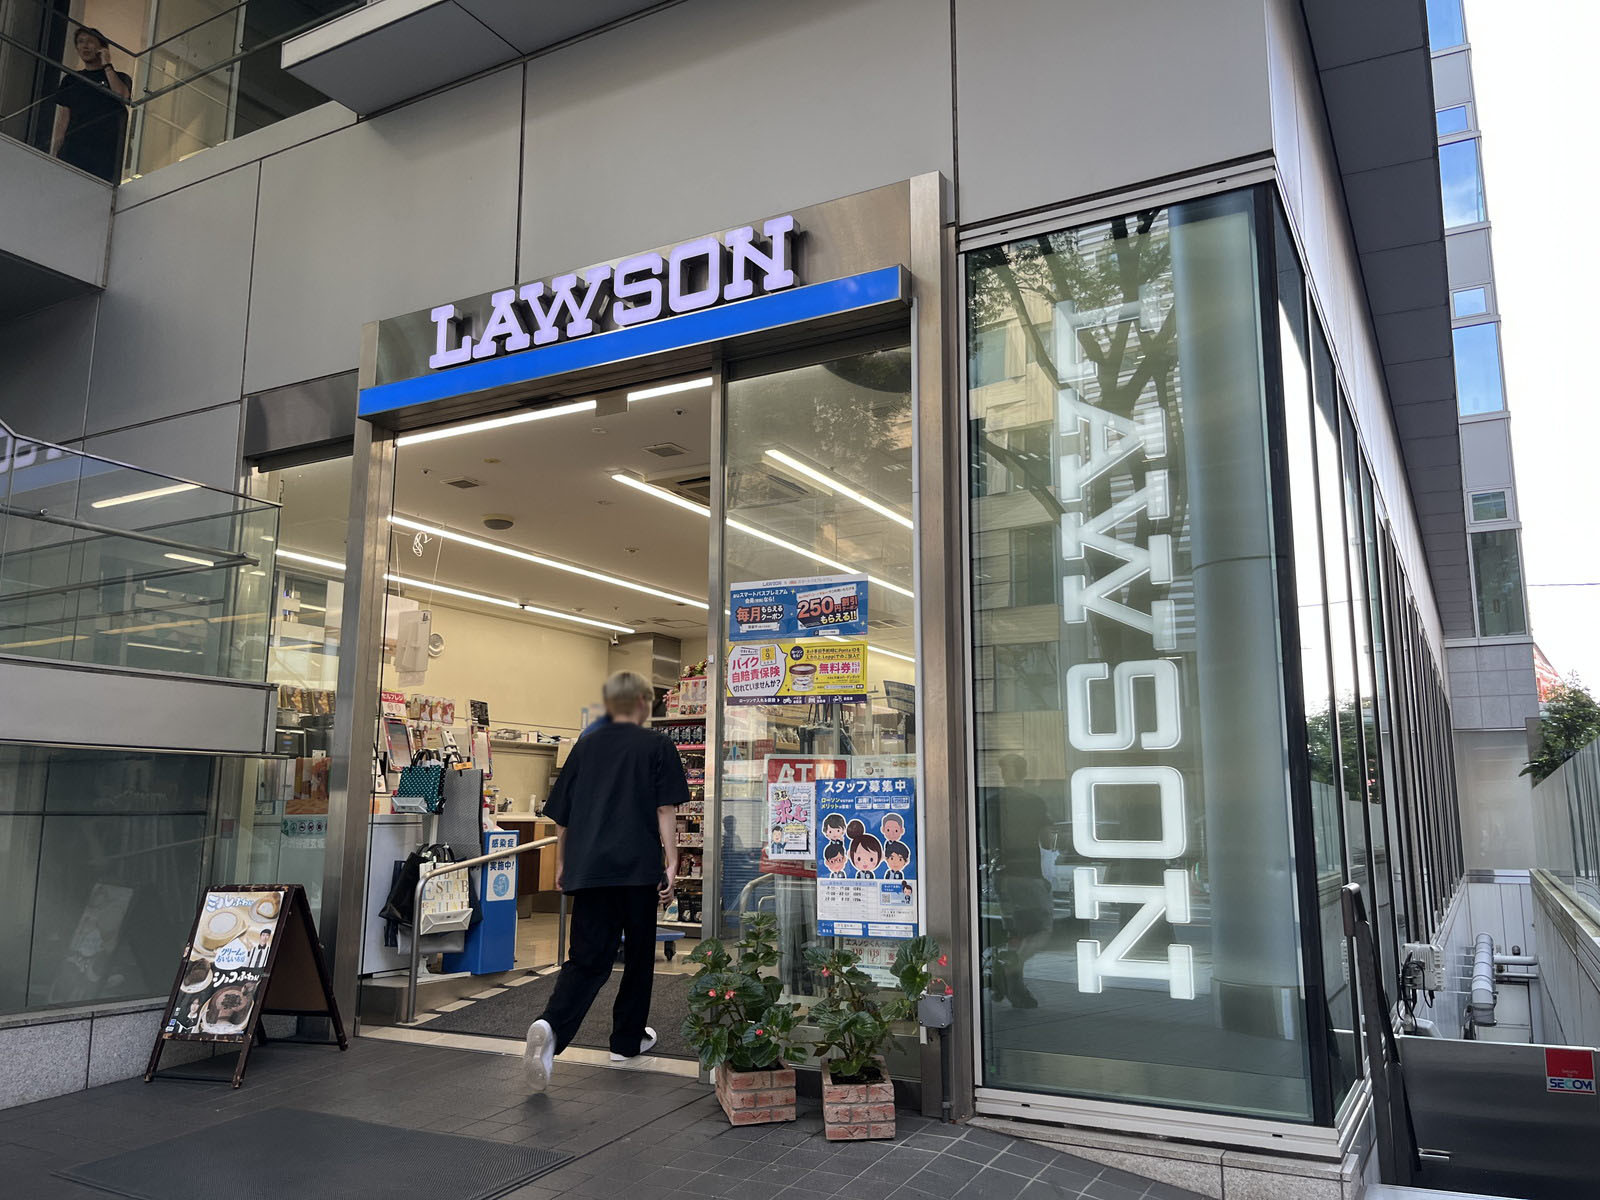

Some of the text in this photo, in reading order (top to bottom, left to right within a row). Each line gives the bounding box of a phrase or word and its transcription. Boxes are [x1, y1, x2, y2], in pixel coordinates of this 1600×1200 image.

[429, 214, 795, 369] LAWSON
[1055, 300, 1196, 1001] LAWSON
[732, 656, 759, 670] バイク
[818, 661, 851, 675] 無料券
[732, 665, 780, 683] 自賠責保険
[776, 763, 835, 784] ATM
[824, 779, 907, 794] スタッフ募集中
[489, 860, 515, 871] 実施中!
[1549, 1077, 1593, 1091] SECOM
